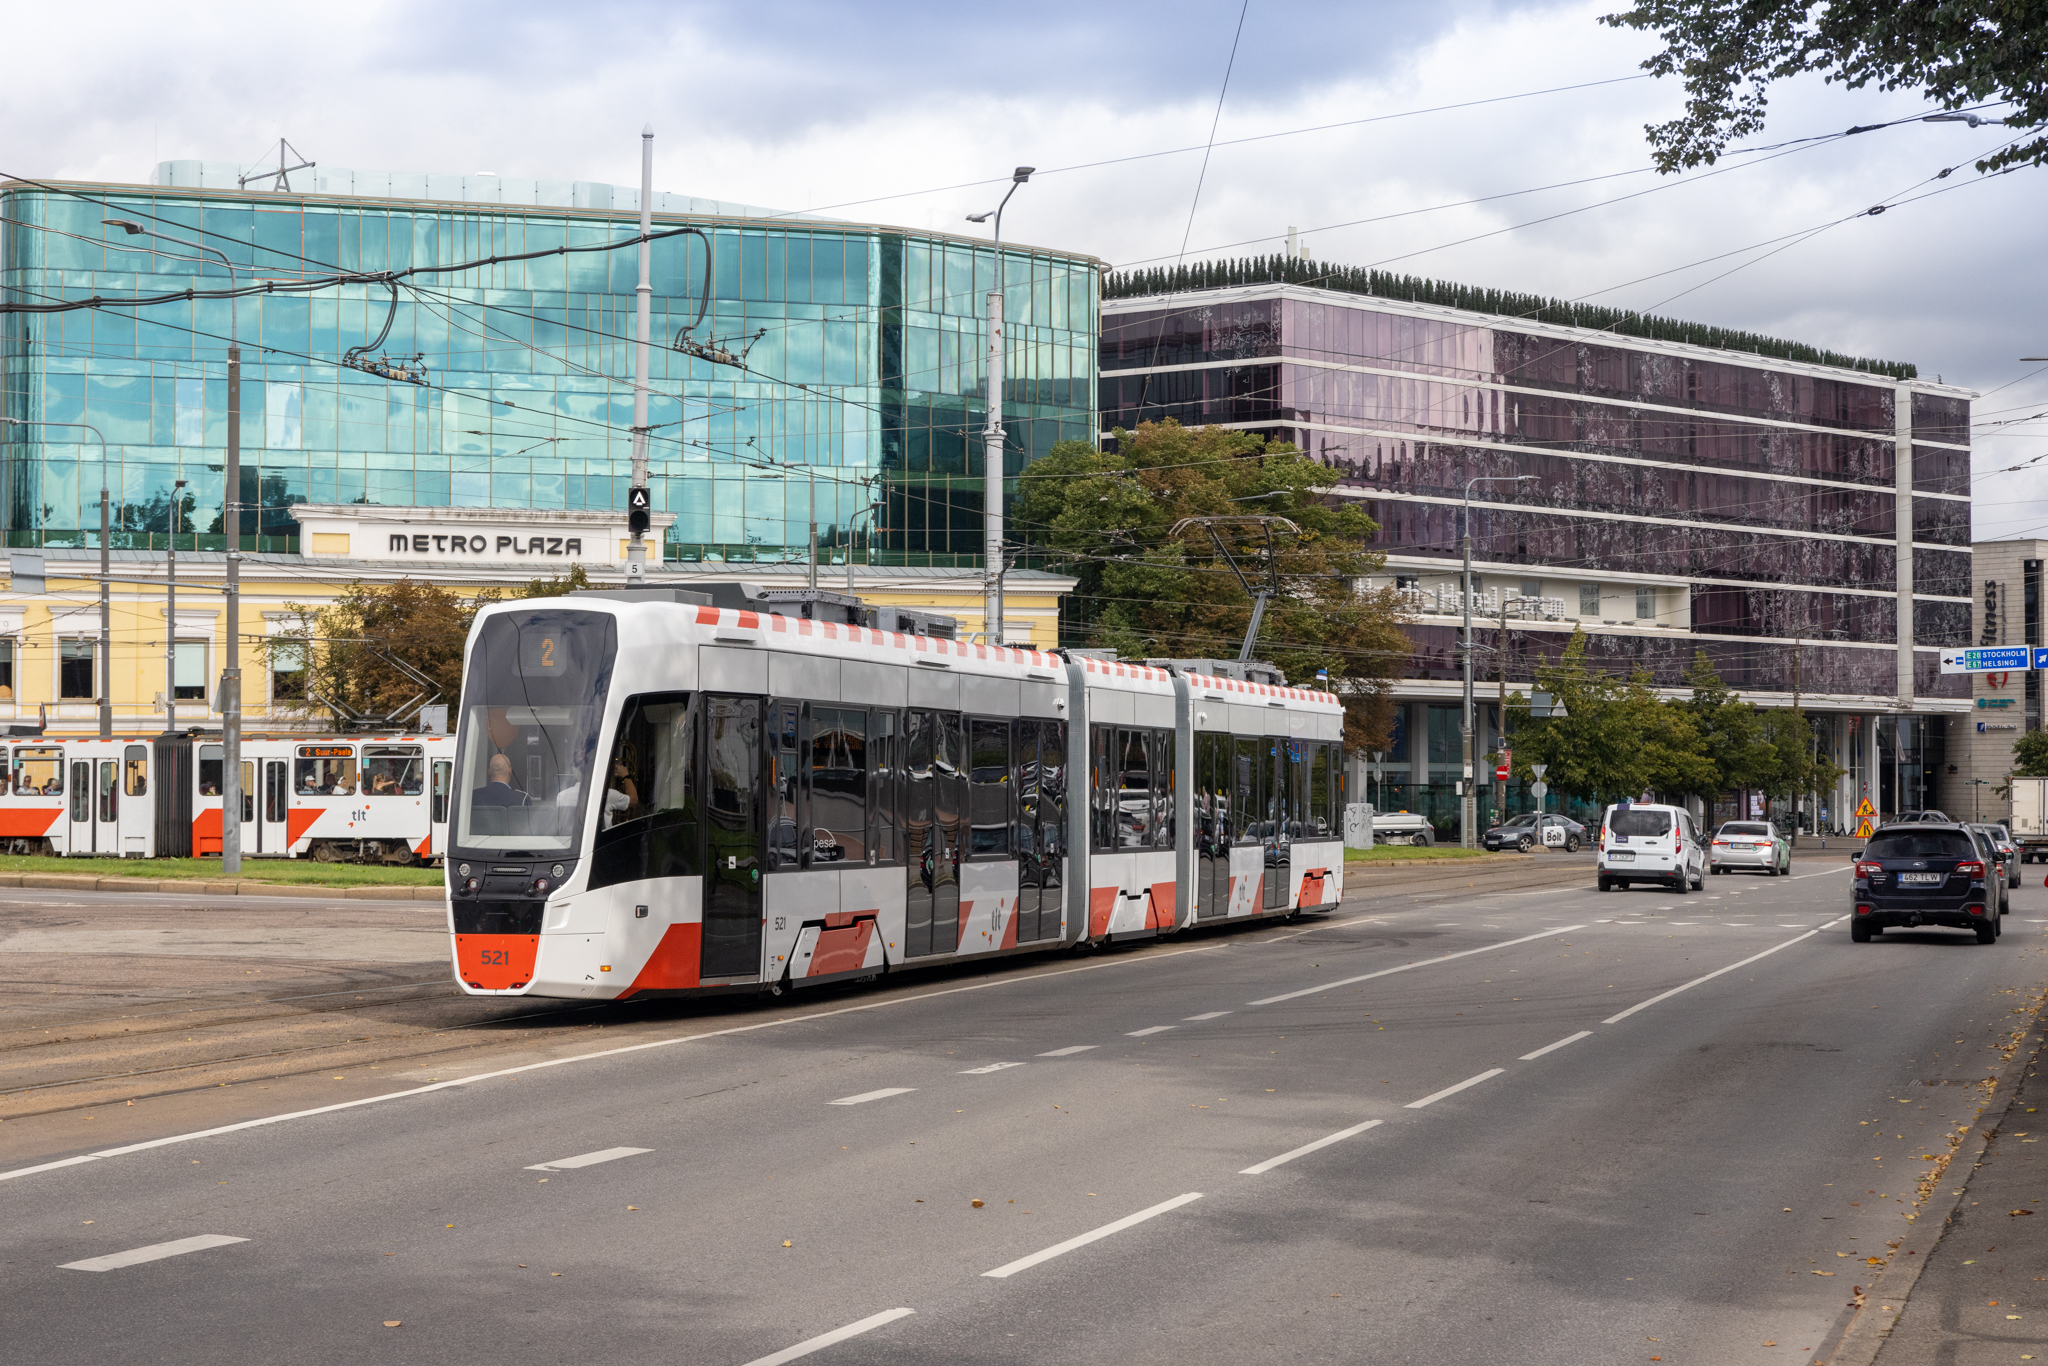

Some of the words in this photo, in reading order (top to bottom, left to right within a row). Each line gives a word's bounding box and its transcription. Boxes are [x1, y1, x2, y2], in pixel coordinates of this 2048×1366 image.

[389, 534, 487, 553] METRO
[496, 535, 582, 556] PLAZA
[631, 564, 638, 574] 5
[541, 638, 554, 667] 2
[1972, 651, 1981, 659] 20
[1982, 650, 2026, 659] STOCKHOLM
[1972, 660, 1981, 668] 67
[305, 748, 311, 757] 2
[315, 748, 352, 756] Suur-Paala
[351, 809, 367, 821] tlt
[1546, 831, 1562, 842] Bolt
[813, 839, 834, 851] pesa
[1904, 873, 1918, 881] 462
[1920, 873, 1938, 881] TLW
[775, 917, 787, 931] 521
[480, 950, 509, 966] 521
